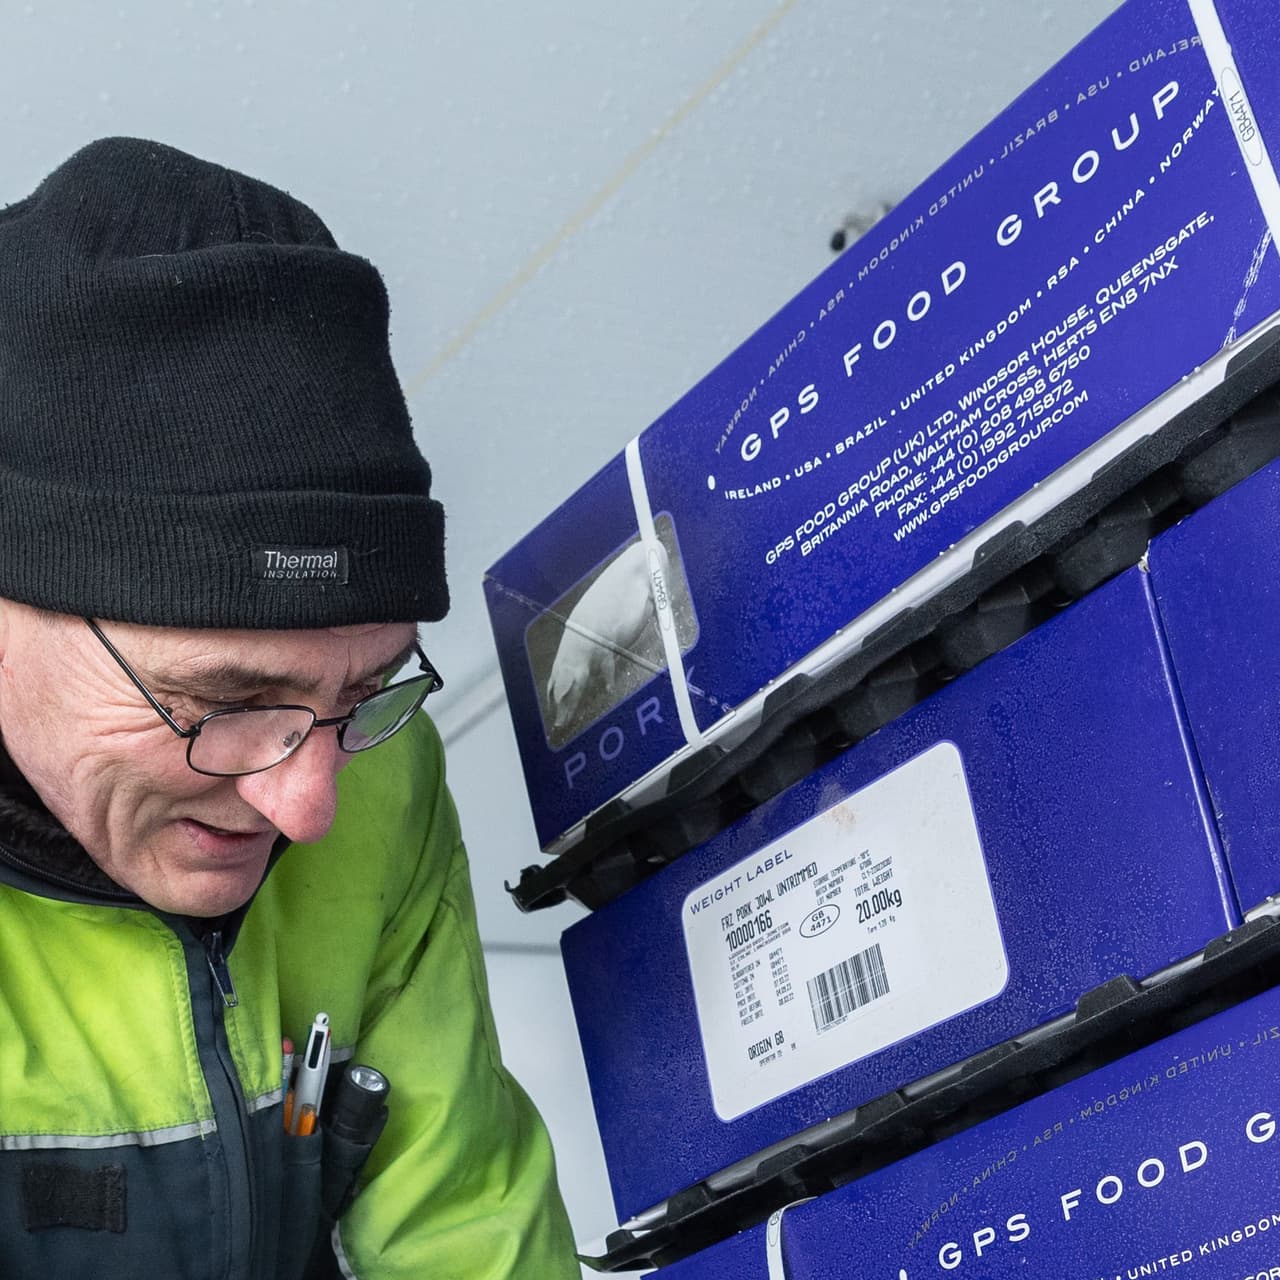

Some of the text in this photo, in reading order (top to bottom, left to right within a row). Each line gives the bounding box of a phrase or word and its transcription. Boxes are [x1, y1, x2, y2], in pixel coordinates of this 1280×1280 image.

[1229, 90, 1254, 142] GB4471
[724, 81, 1219, 499] IRELAND USA BRAZIL UNITED KINGDOM RSA CHINA NORWAY
[740, 80, 1179, 461] GPS FOOD GROUP
[765, 211, 1214, 564] GPS FOOD GROUP (UK) LTD, WINDSOR HOUSE, QUEENSGATE,
[800, 255, 1178, 556] BRITANNIA ROAD, WALTHAM CROSS, HERTS EN8 7NX
[874, 345, 1090, 517] PHONE: +44 (0) 208 498 6750
[897, 378, 1074, 519] FAX: +44 (0) 1992 715872
[893, 389, 1088, 541] WWW.GPSFOODGROUP.COM
[264, 551, 337, 568] Thermal
[264, 570, 337, 579] INSULATION
[690, 849, 792, 915] WEIGHT LABEL
[725, 909, 772, 951] 10000166
[855, 887, 902, 923] 20.00kg
[939, 1213, 1030, 1269] GPS
[1060, 1140, 1207, 1220] FOOD
[1127, 1249, 1192, 1279] UNITED
